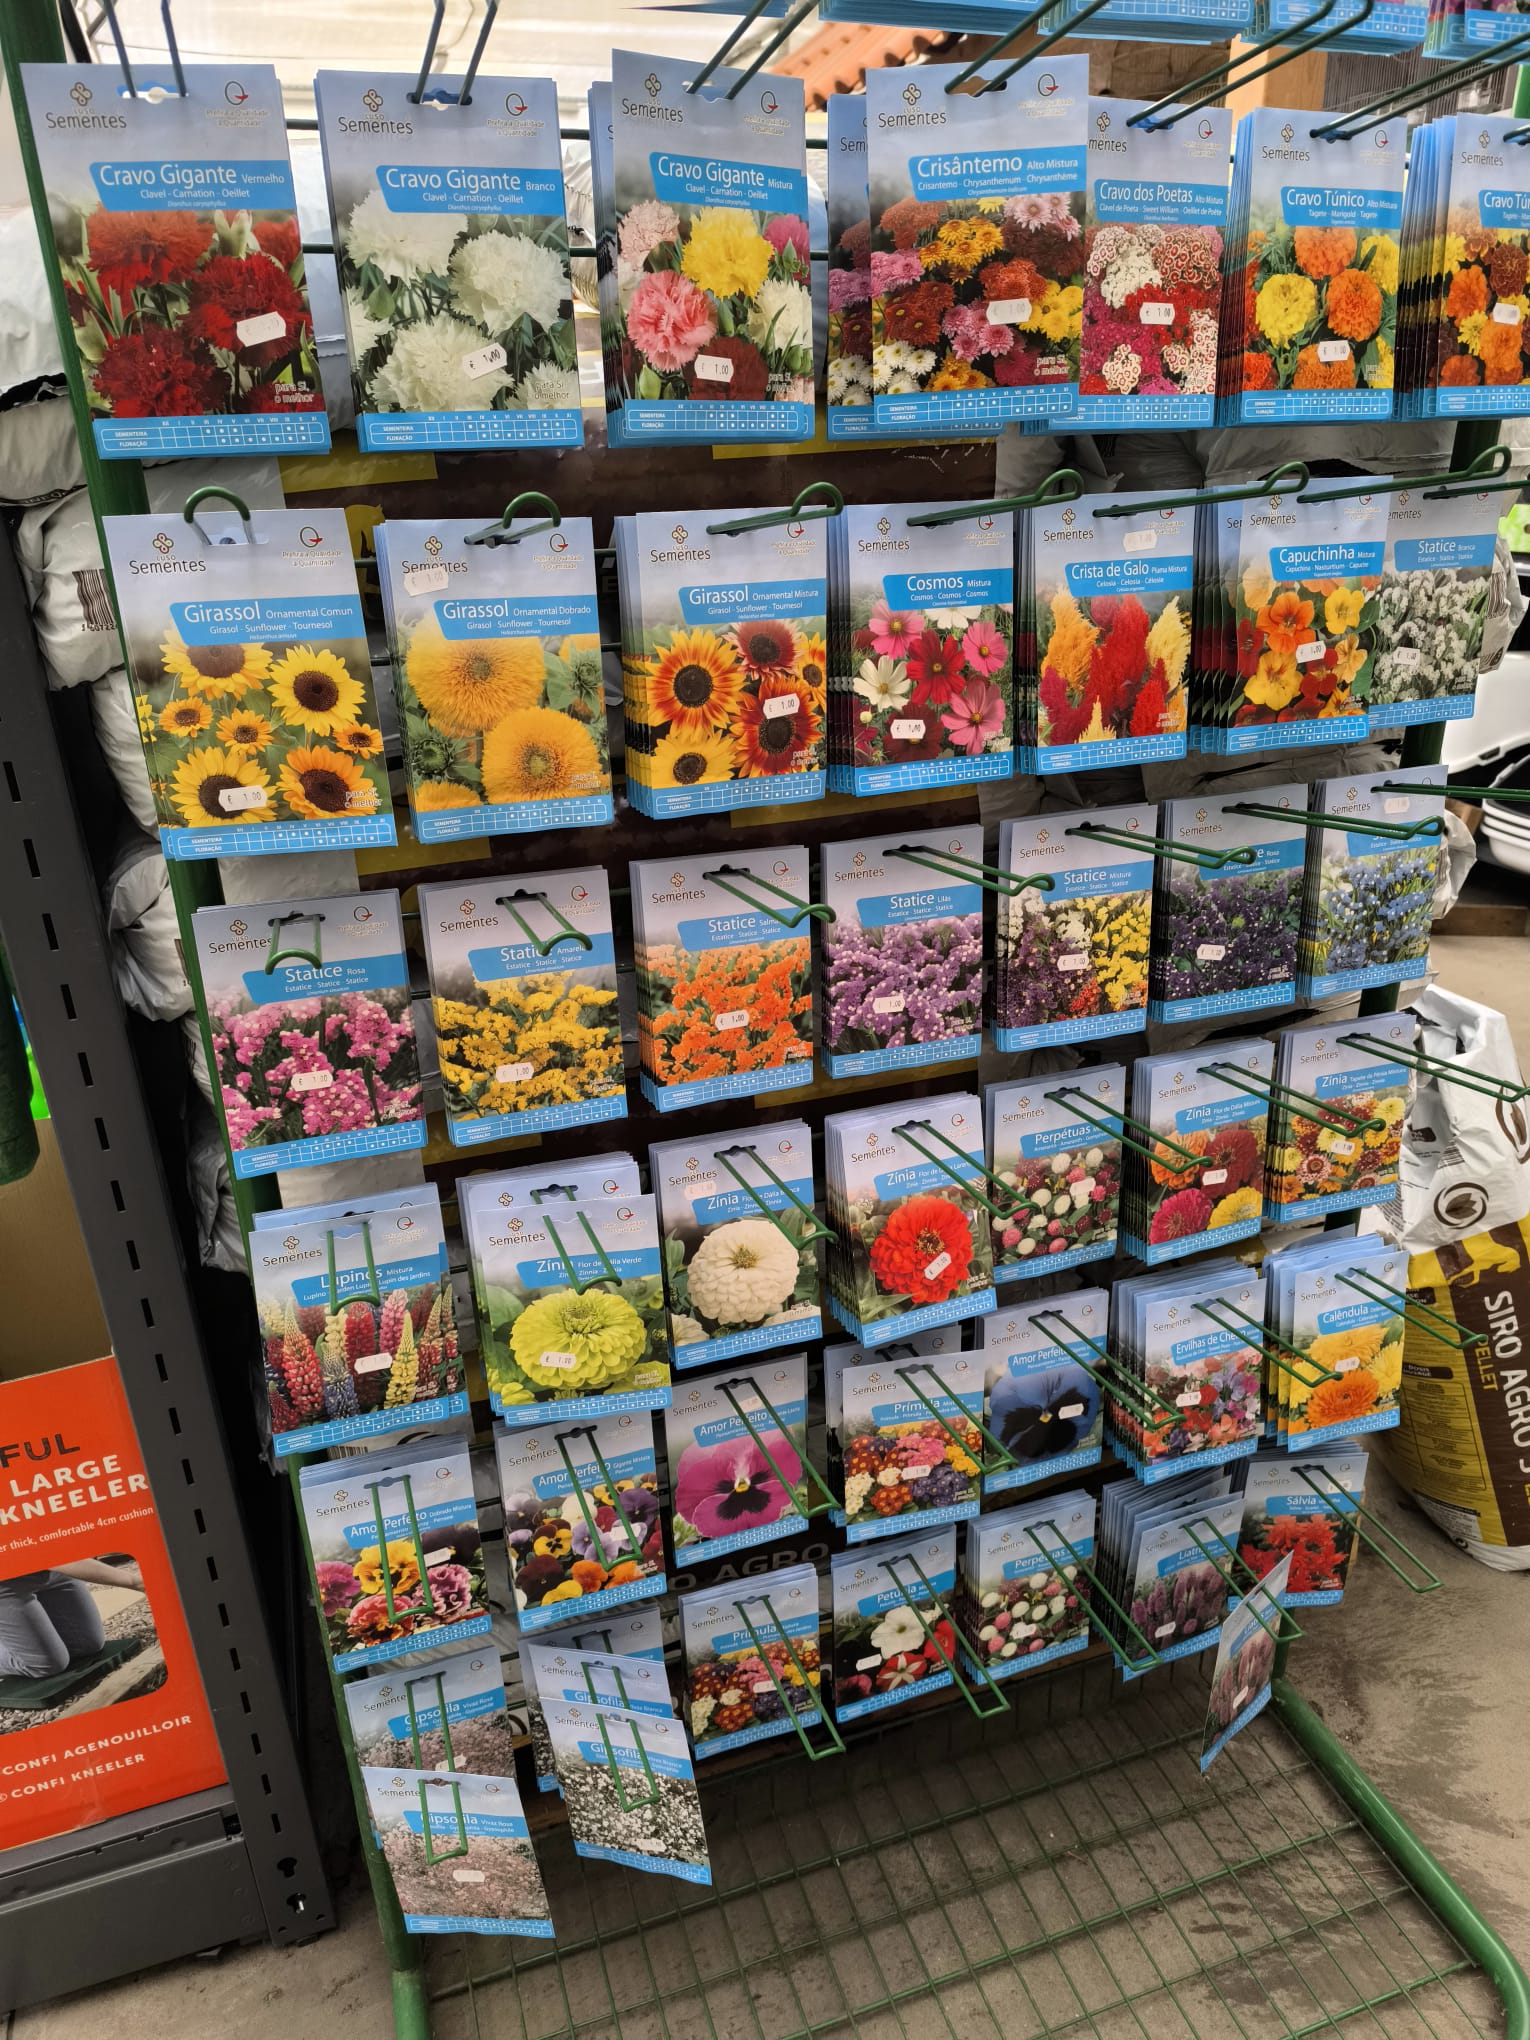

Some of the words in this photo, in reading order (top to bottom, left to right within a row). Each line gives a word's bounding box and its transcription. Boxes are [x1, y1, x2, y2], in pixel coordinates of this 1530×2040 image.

[622, 98, 684, 123] Sementes
[45, 113, 127, 129] Sementes
[338, 116, 413, 134] Sementes
[878, 112, 946, 128] Sementes
[1262, 146, 1310, 161] Sementes
[1461, 151, 1503, 166] Sementes
[658, 156, 702, 179] Cravo
[706, 162, 764, 188] Gigante
[767, 179, 792, 190] Mistura
[917, 156, 1022, 178] Crisântemo
[1027, 159, 1045, 170] Alto
[1047, 158, 1078, 169] Mistura
[99, 165, 156, 186] Cravo
[160, 164, 237, 189] Gigante
[241, 173, 284, 185] Vermelho
[385, 168, 442, 189] Cravo
[446, 170, 521, 193] Gigante
[525, 182, 555, 191] Branco
[963, 176, 1021, 189] Chrysanthemum
[140, 189, 166, 199] Clavel
[172, 188, 215, 199] Carnation
[221, 188, 250, 199] Oeillet
[422, 193, 447, 202] Clavel
[453, 194, 492, 203] Carnation
[498, 194, 523, 203] Oeillet
[686, 183, 705, 194] Clavel
[710, 186, 743, 197] Carnation
[748, 189, 768, 199] Oeillet
[1100, 182, 1131, 200] Cravo
[1134, 183, 1154, 201] dos
[1157, 184, 1193, 203] Poetas
[1286, 188, 1321, 206] Cravo
[1324, 190, 1365, 207] Túnico
[1484, 192, 1514, 208] Cravo
[1250, 513, 1296, 526] Sementes
[1043, 529, 1094, 542] Sementes
[858, 539, 910, 552] Sementes
[1418, 540, 1456, 554] Statice
[650, 549, 711, 563] Sementes
[1279, 545, 1355, 564] Capuchinha
[129, 560, 206, 575] Sementes
[1072, 563, 1103, 580] Crista
[1106, 562, 1120, 577] de
[1123, 560, 1149, 576] Galo
[1314, 562, 1345, 571] Nasturtium
[907, 576, 963, 591] Cosmos
[1096, 580, 1116, 588] Celosia
[1121, 578, 1140, 586] Celosia
[689, 585, 749, 605] Girassol
[753, 591, 793, 600] Ornamental
[794, 590, 819, 598] Mistura
[911, 593, 933, 601] Cosmos
[184, 601, 261, 623] Girassol
[266, 608, 318, 619] Ornamental
[320, 607, 353, 616] Comun
[443, 600, 509, 620] Girassol
[513, 607, 558, 616] Ornamental
[559, 606, 591, 615] Dobrado
[708, 606, 731, 615] Girasol
[736, 605, 768, 613] Sunflower
[773, 602, 803, 611] Tournesol
[210, 624, 238, 635] Girasol
[245, 623, 286, 633] Sunflower
[293, 621, 333, 630] Tournesol
[467, 621, 491, 629] Girasol
[498, 620, 533, 628] Sunflower
[1332, 802, 1370, 815] Sementes
[1179, 823, 1222, 837] Sementes
[1020, 844, 1065, 858] Sementes
[835, 868, 884, 881] Sementes
[1064, 870, 1107, 885] Statice
[652, 889, 706, 904] Sementes
[890, 894, 935, 909] Statice
[440, 916, 499, 933] Sementes
[708, 917, 756, 933] Statice
[506, 962, 530, 970] Estatice
[285, 966, 342, 983] Statice
[347, 967, 365, 975] Rosa
[285, 984, 312, 993] Estatice
[317, 980, 340, 988] Statice
[346, 976, 369, 985] Statice
[1300, 1051, 1339, 1064] Sementes
[1322, 1076, 1347, 1087] Zínia
[1159, 1084, 1197, 1098] Sementes
[1002, 1108, 1045, 1122] Sementes
[1186, 1107, 1210, 1120] Zínia
[1036, 1125, 1091, 1144] Perpétuas
[851, 1145, 896, 1163] Sementes
[669, 1170, 717, 1186] Sementes
[888, 1169, 915, 1186] Zínia
[708, 1194, 738, 1210] Zínia
[489, 1232, 546, 1246] Sementes
[263, 1249, 322, 1266] Sementes
[622, 1256, 642, 1264] Verde
[387, 1266, 412, 1276] Mistura
[304, 1291, 326, 1301] Lupino
[409, 1272, 431, 1281] jardins
[1301, 1288, 1336, 1301] Sementes
[1323, 1305, 1368, 1323] Calêndula
[1153, 1317, 1191, 1332] Sementes
[1484, 1291, 1522, 1358] SIRO
[992, 1331, 1030, 1345] Sementes
[1176, 1341, 1206, 1354] Ervilhas
[1208, 1336, 1218, 1345] de
[1013, 1354, 1036, 1366] Amor
[853, 1382, 897, 1396] Sementes
[673, 1400, 718, 1416] Sementes
[700, 1423, 727, 1436] Amor
[509, 1448, 558, 1466] Sementes
[10, 1454, 122, 1498] LARGE
[539, 1472, 568, 1487] Amor
[613, 1460, 632, 1469] Gigante
[633, 1455, 650, 1463] Mistura
[1253, 1478, 1290, 1487] Sementes
[0, 1474, 149, 1526] KNEELER
[1287, 1496, 1316, 1505] Sálvia
[316, 1499, 370, 1517] Sementes
[10, 1537, 38, 1550] thick,
[39, 1522, 94, 1542] comfortable
[97, 1517, 117, 1527] 4cm
[119, 1506, 154, 1521] cushion
[987, 1540, 1024, 1555] Sementes
[712, 1542, 829, 1583] AGRO
[840, 1576, 879, 1593] Sementes
[692, 1614, 734, 1629] Sementes
[2, 1754, 57, 1776] CONFI
[64, 1715, 192, 1759] AGENOUILLOIR
[10, 1777, 65, 1799] CONFI
[71, 1754, 145, 1782] KNEELER
